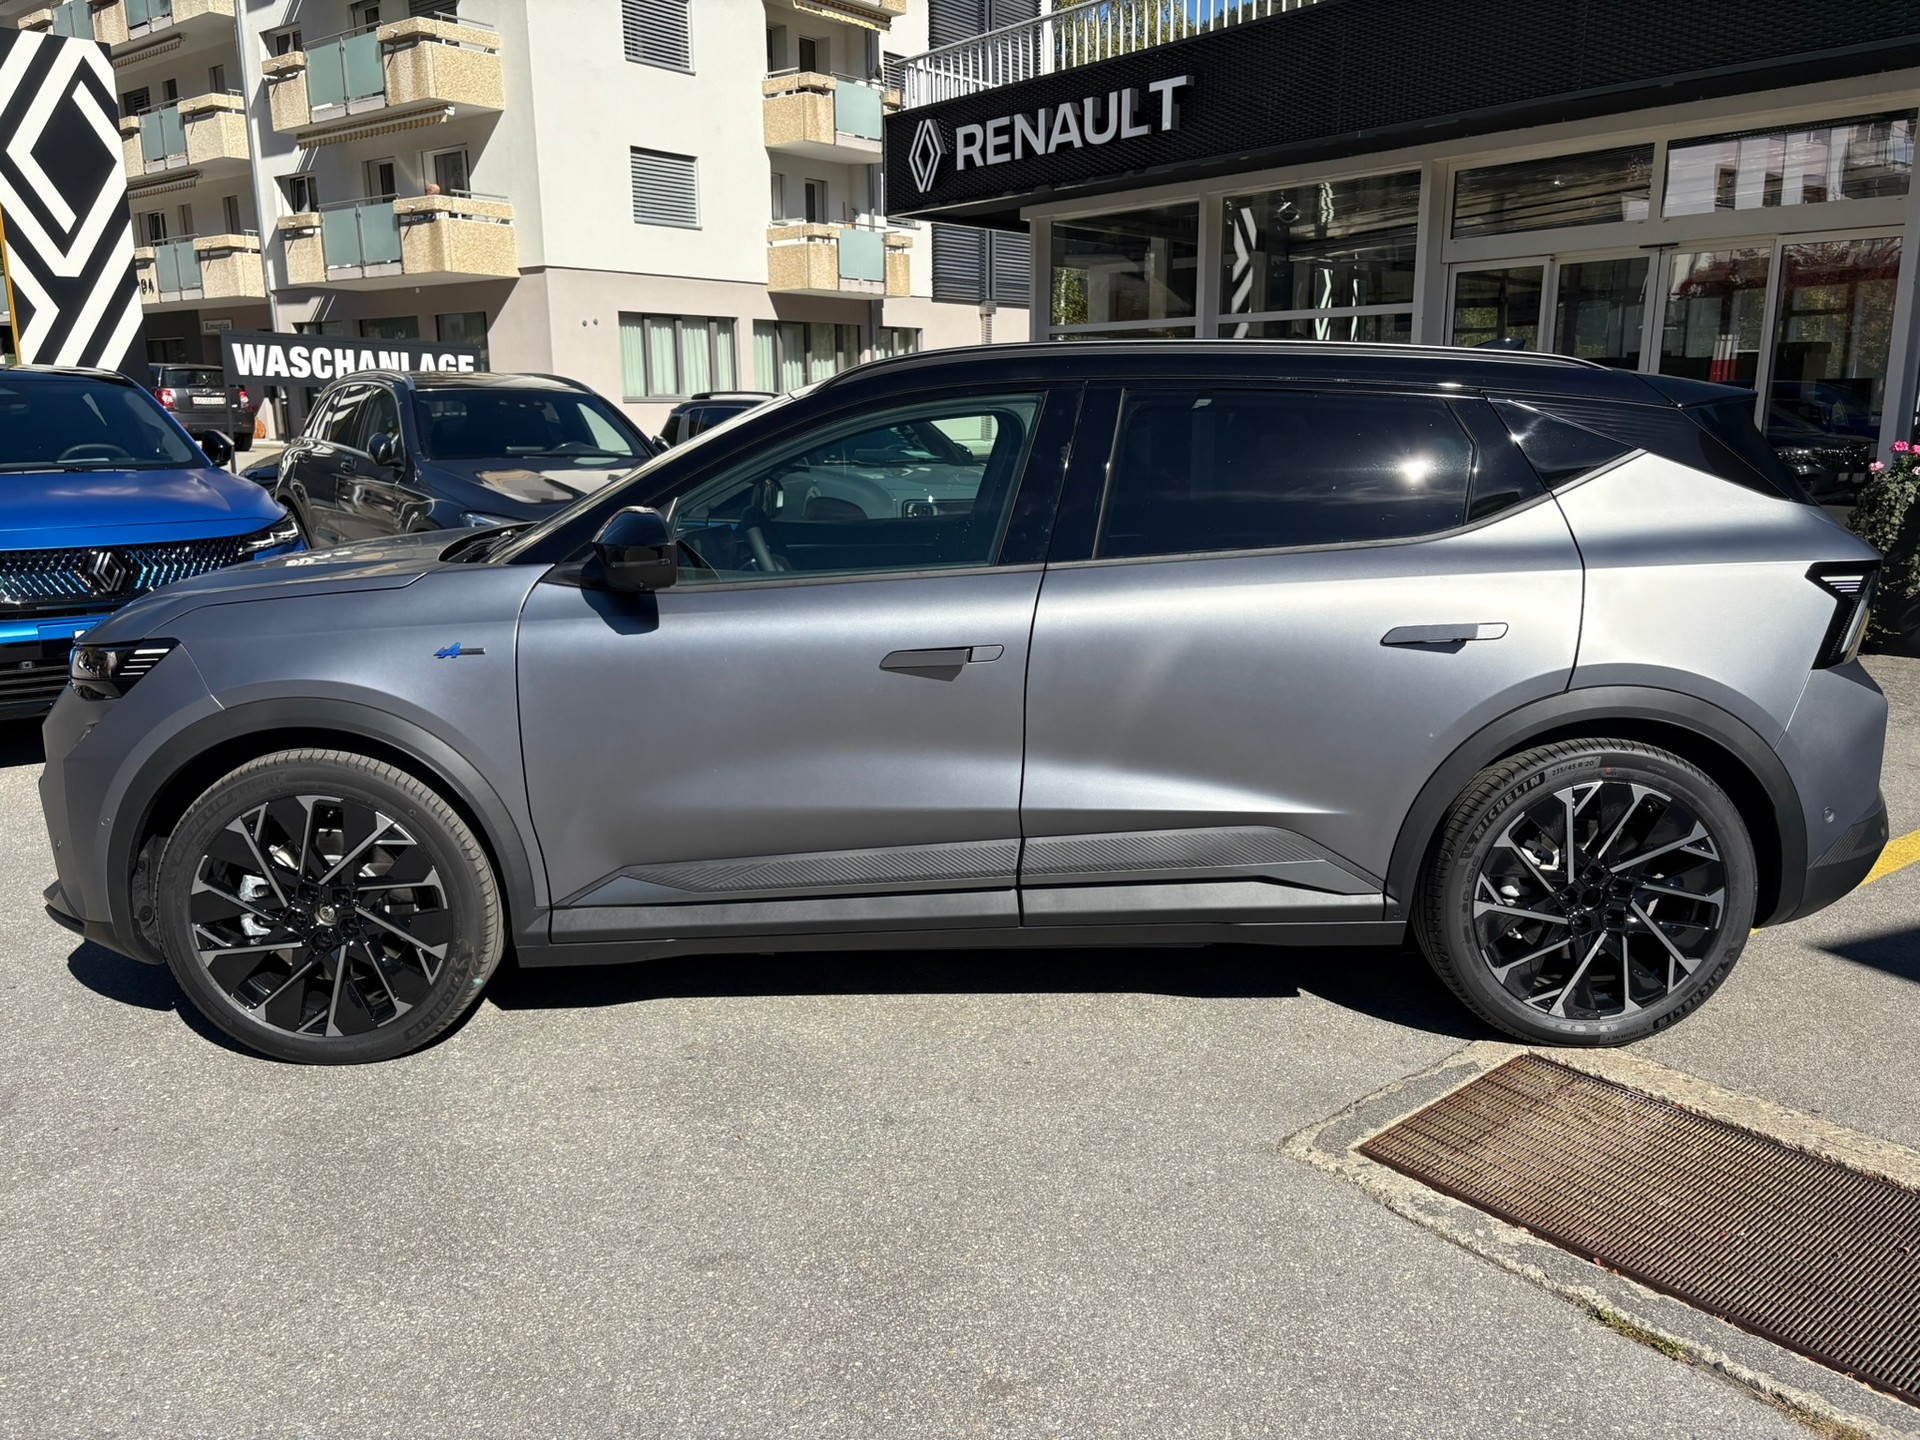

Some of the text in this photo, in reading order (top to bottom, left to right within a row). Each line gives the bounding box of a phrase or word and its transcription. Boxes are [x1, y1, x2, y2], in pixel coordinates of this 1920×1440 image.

[955, 75, 1195, 171] RENAULT
[1552, 762, 1576, 776] 235/45
[1473, 774, 1542, 840] MICHELIN
